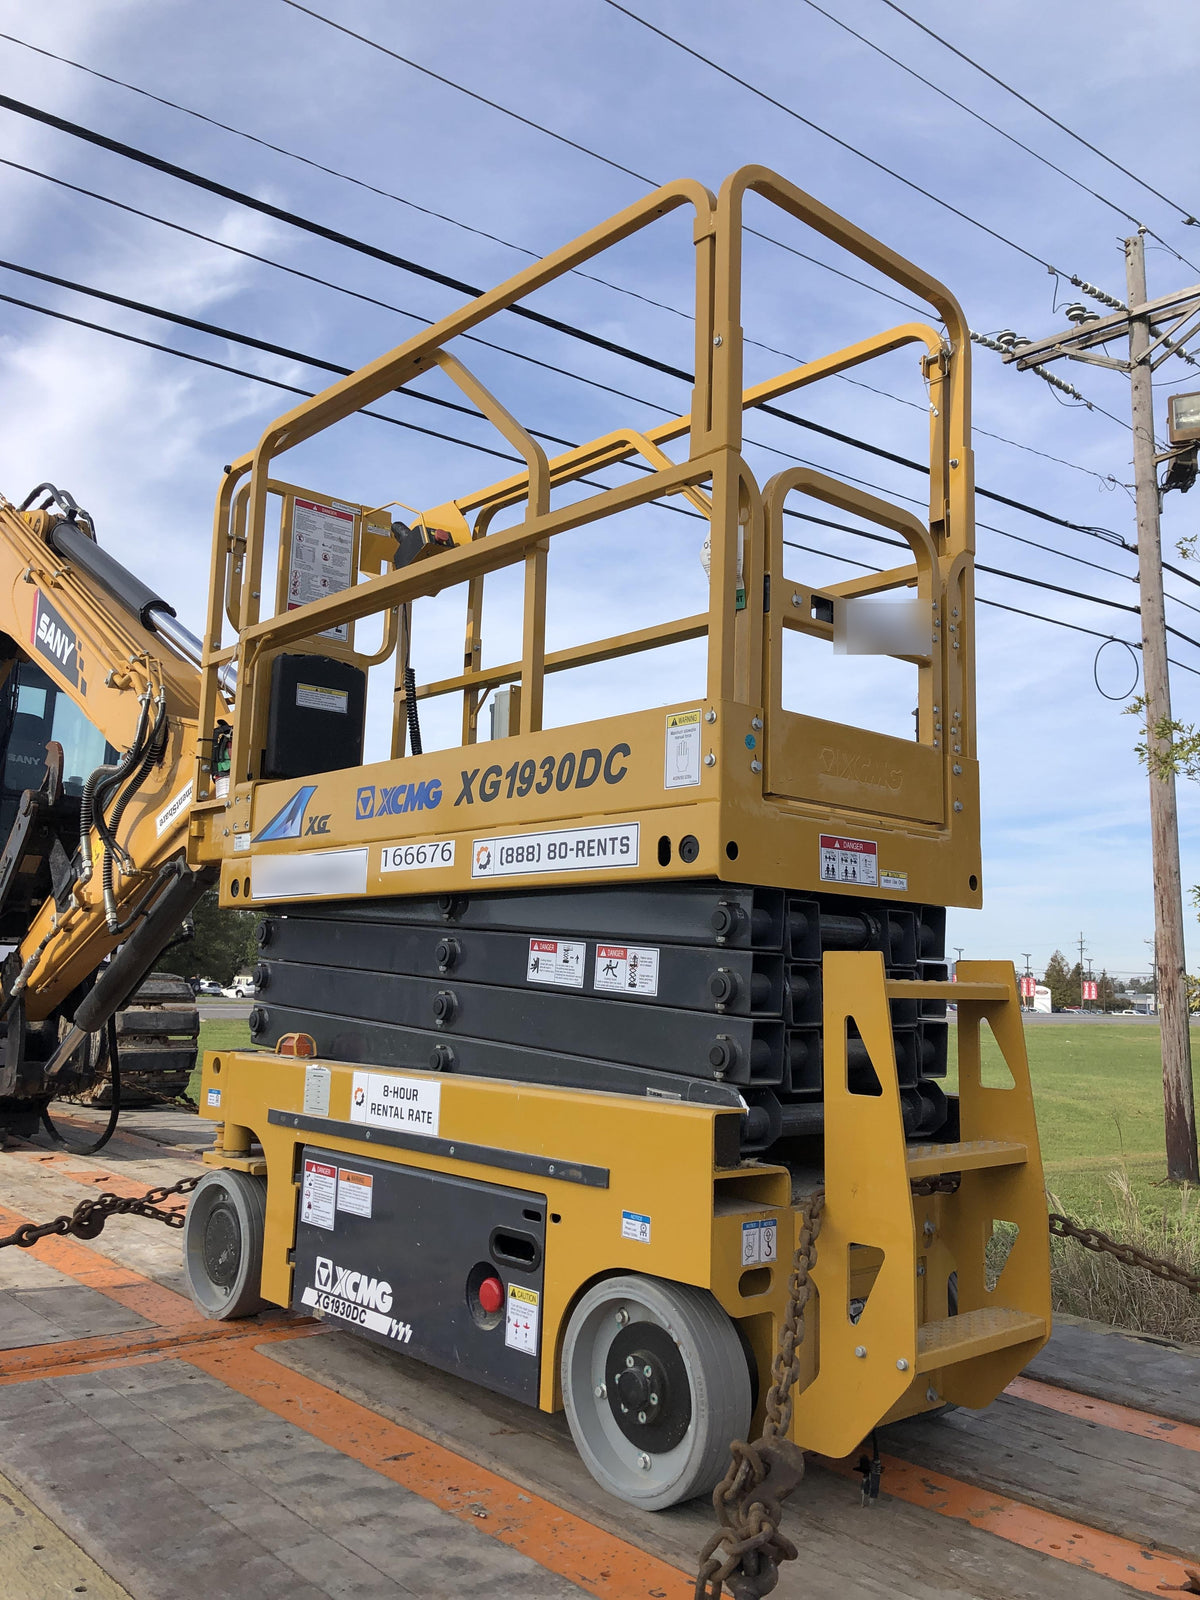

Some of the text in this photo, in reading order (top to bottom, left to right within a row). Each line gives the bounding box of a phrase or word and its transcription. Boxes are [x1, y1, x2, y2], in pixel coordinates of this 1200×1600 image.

[37, 612, 75, 666] SANY
[678, 715, 697, 724] WARNING
[8, 753, 41, 766] SANY
[454, 742, 632, 807] XG1930DC
[374, 778, 443, 817] XCMG
[305, 814, 331, 836] XG
[382, 842, 452, 868] 166676
[499, 836, 630, 866] (888) 80-RENTS
[843, 841, 864, 851] DANGER
[540, 943, 555, 951] DANGER
[607, 949, 624, 958] DANGER
[382, 1084, 419, 1102] 8-HOUR
[370, 1103, 433, 1125] RENTAL RATE
[317, 1166, 331, 1175] DANGER
[332, 1266, 393, 1314] XCMG
[517, 1290, 537, 1303] CAUTION
[314, 1291, 367, 1324] XG1930DC
